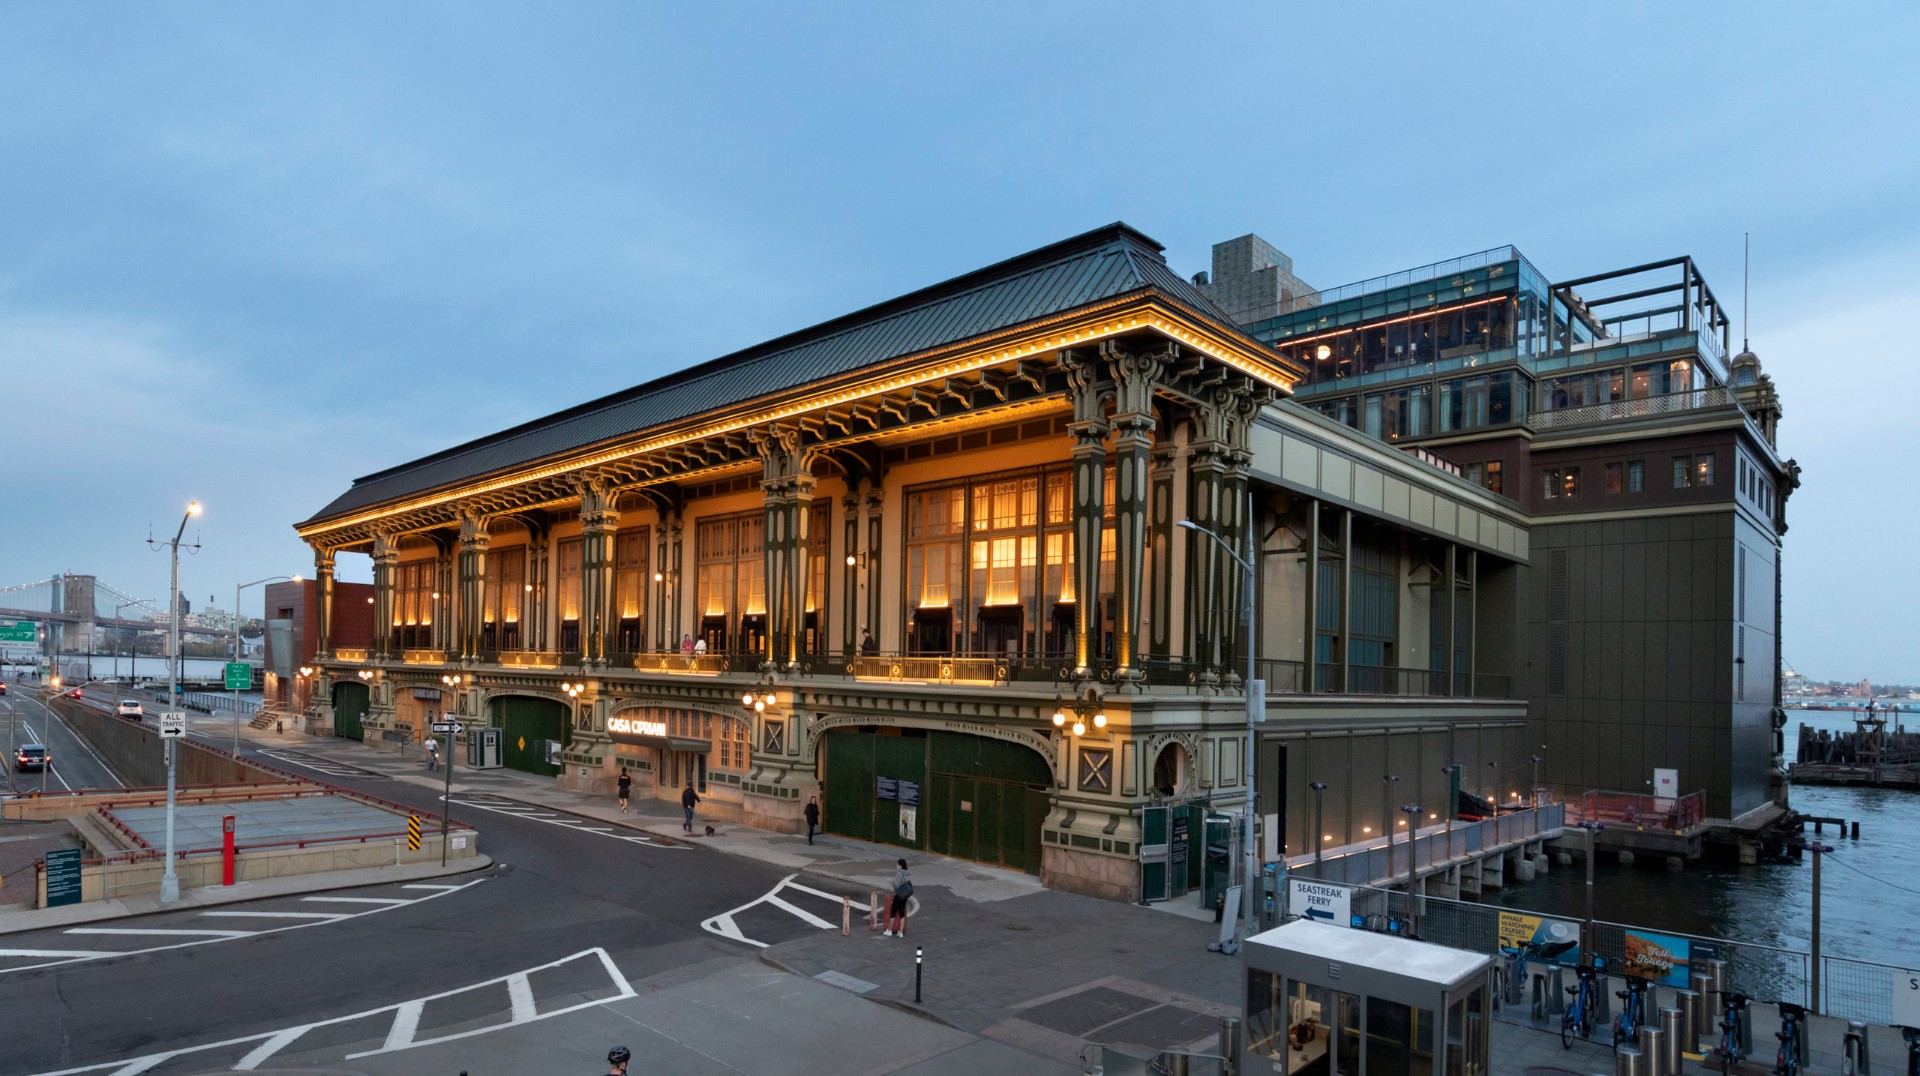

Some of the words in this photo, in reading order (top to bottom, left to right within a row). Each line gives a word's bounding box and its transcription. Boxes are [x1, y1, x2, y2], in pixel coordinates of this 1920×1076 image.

[608, 718, 631, 732] CASA
[632, 720, 666, 736] CIPRIANI
[1297, 884, 1342, 898] SEASTREAK
[1308, 896, 1331, 906] FERRY
[1501, 914, 1523, 922] WHALE
[1501, 920, 1535, 931] WATCHING
[1501, 926, 1526, 935] CRUISES
[1648, 946, 1668, 957] Fall
[1636, 954, 1674, 970] Foliage
